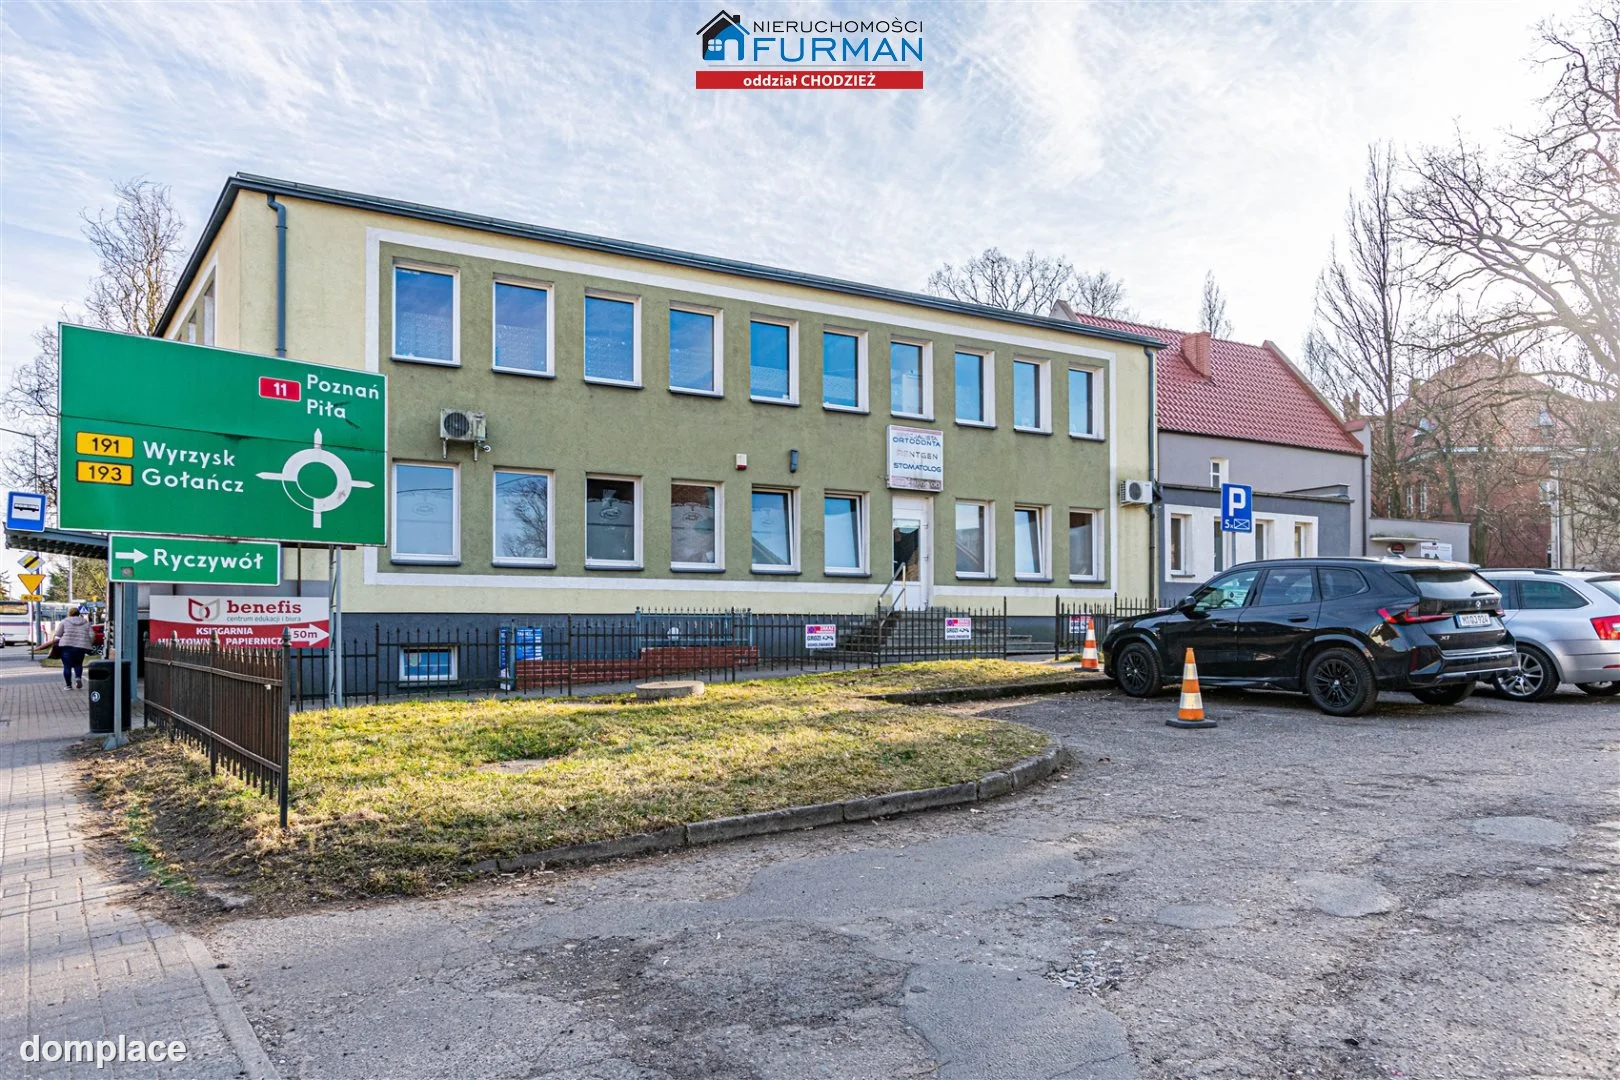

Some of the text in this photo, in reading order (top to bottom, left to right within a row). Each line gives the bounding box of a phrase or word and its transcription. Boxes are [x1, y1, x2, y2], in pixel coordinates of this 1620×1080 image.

[273, 382, 287, 397] 11
[307, 373, 379, 400] Poznań
[307, 399, 346, 419] Piła
[92, 437, 120, 454] 191
[892, 436, 941, 447] ORTODONTA
[142, 440, 235, 469] Wyrzysk
[89, 465, 122, 482] 193
[893, 462, 942, 473] STOMATOLOG
[142, 467, 244, 493] Gołańcz
[1228, 486, 1246, 517] P
[153, 548, 264, 573] Ryczywół
[226, 599, 302, 614] benefis
[255, 615, 280, 623] edukacji
[225, 637, 285, 645] PAPIERNICZ
[293, 630, 318, 639] 50m
